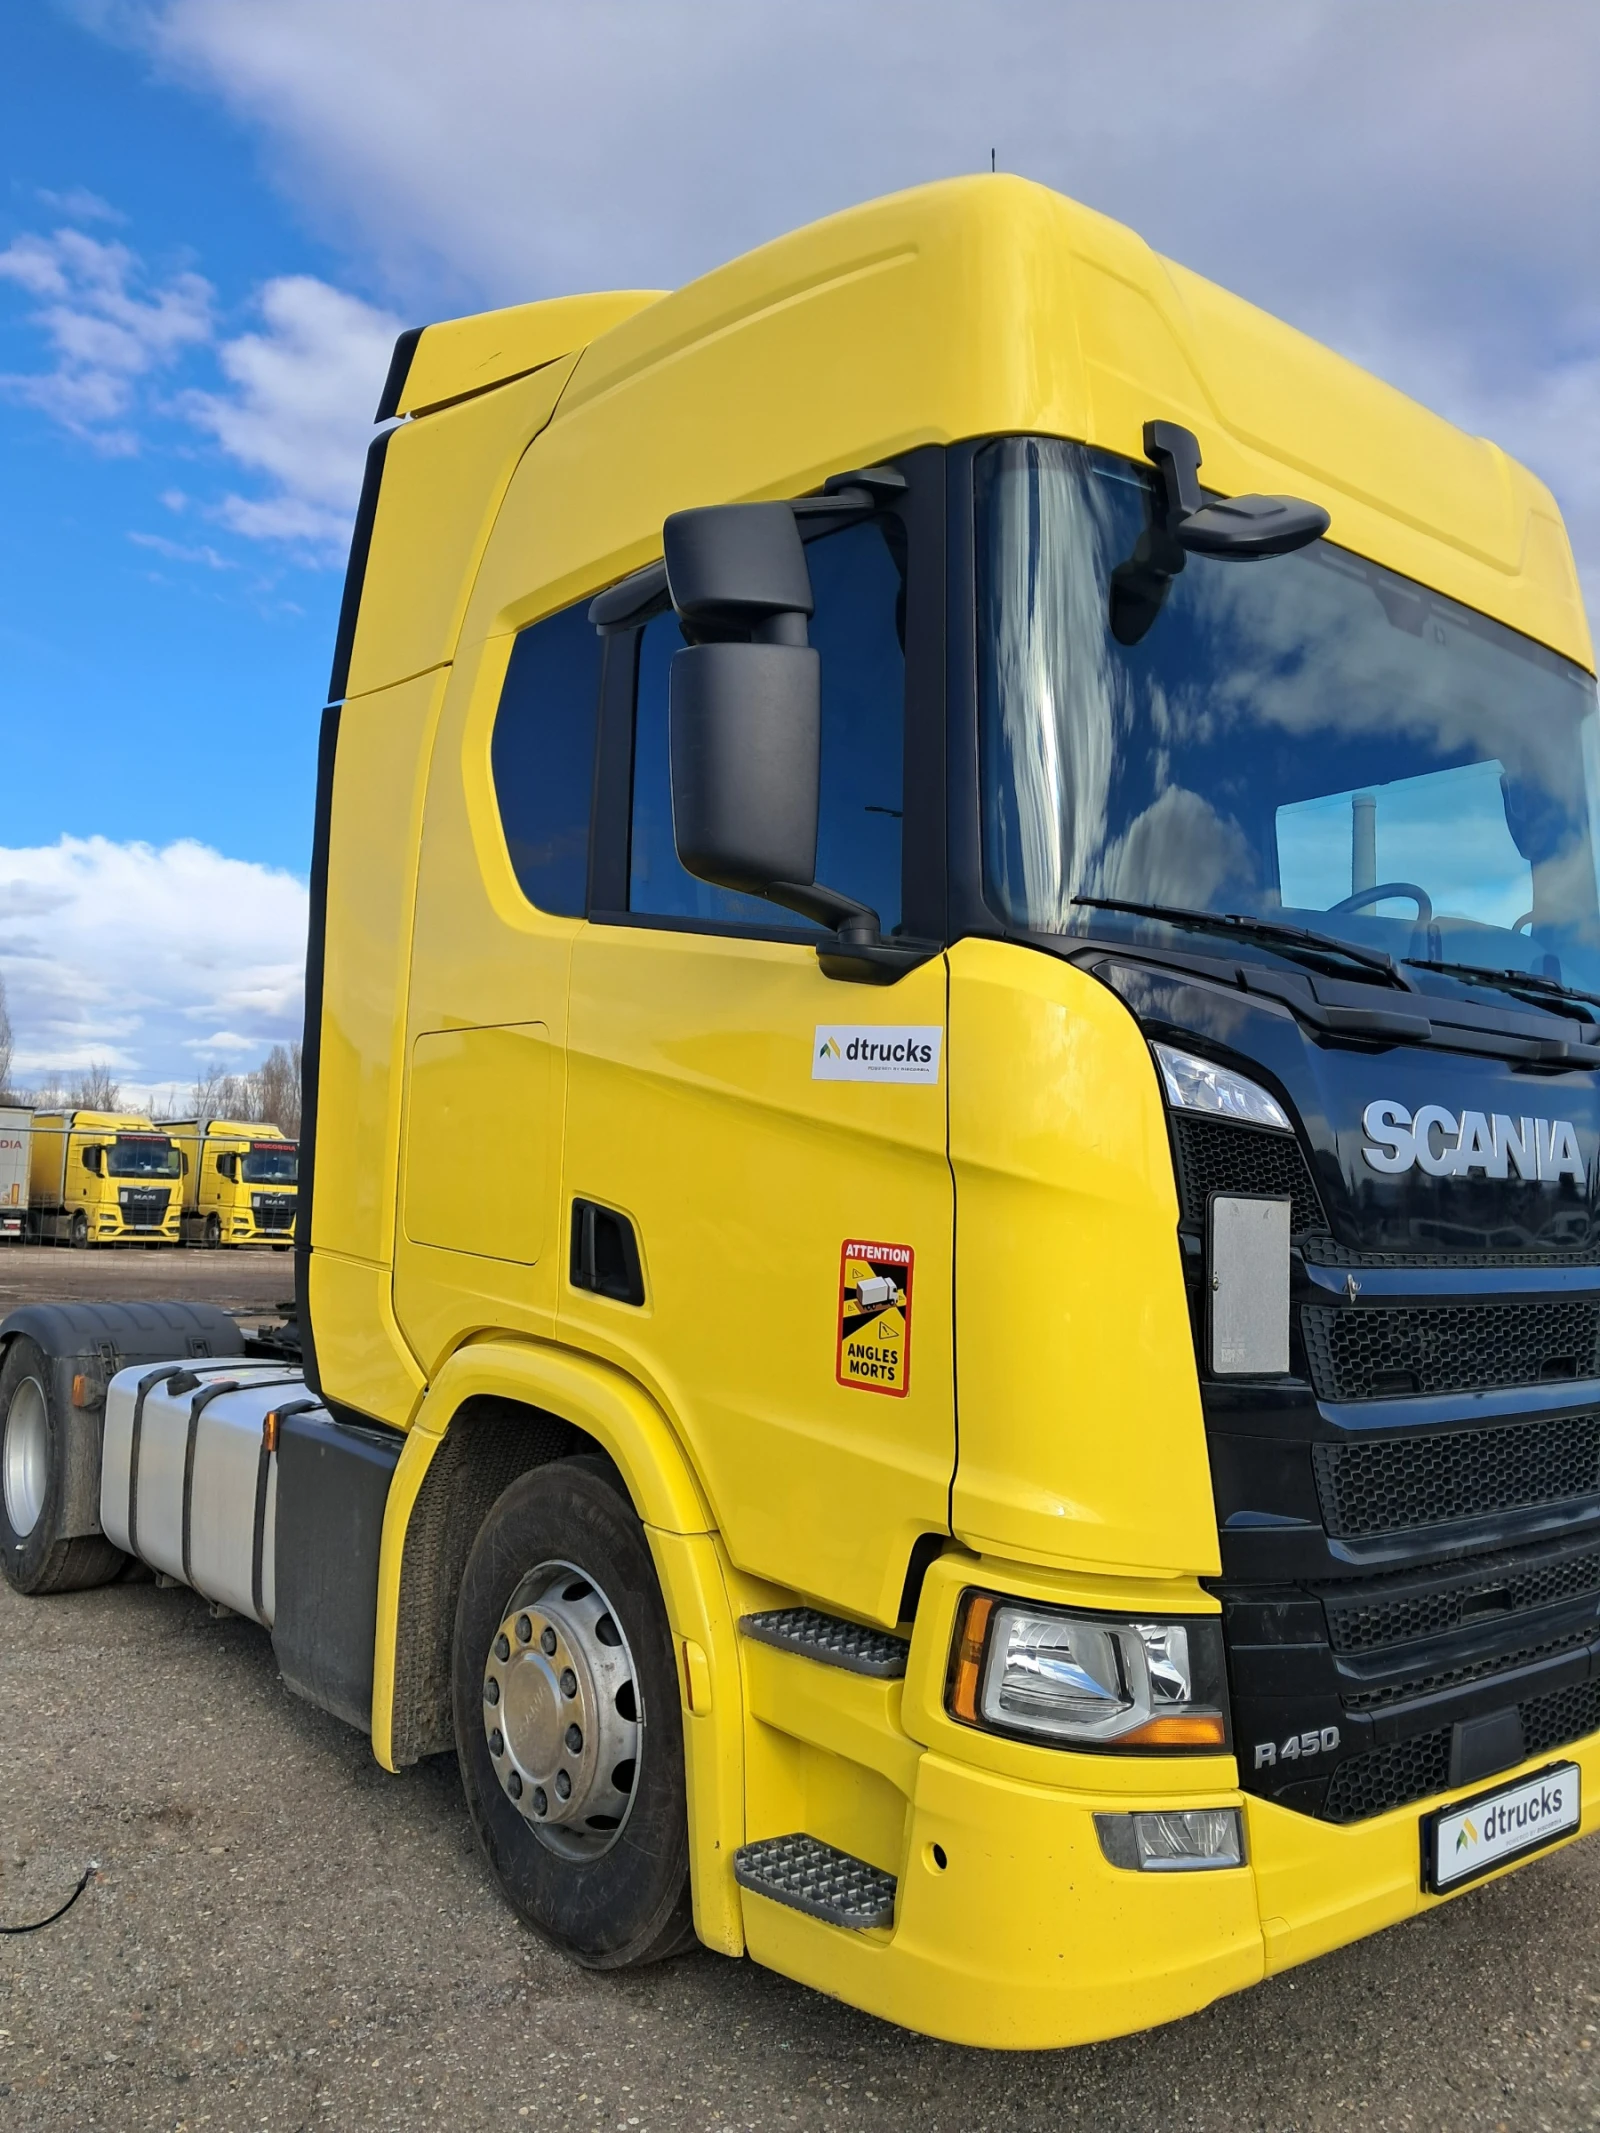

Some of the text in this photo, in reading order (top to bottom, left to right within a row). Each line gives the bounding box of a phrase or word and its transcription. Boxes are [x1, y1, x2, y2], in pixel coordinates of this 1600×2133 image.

[846, 1037, 932, 1063] dtrucks
[1361, 1099, 1586, 1184] SCANIA
[846, 1244, 910, 1264] ATTENTION
[848, 1343, 898, 1365] ANGLES
[850, 1360, 895, 1381] MORTS
[1254, 1726, 1341, 1769] R 450
[1484, 1786, 1563, 1842] dtrucks
